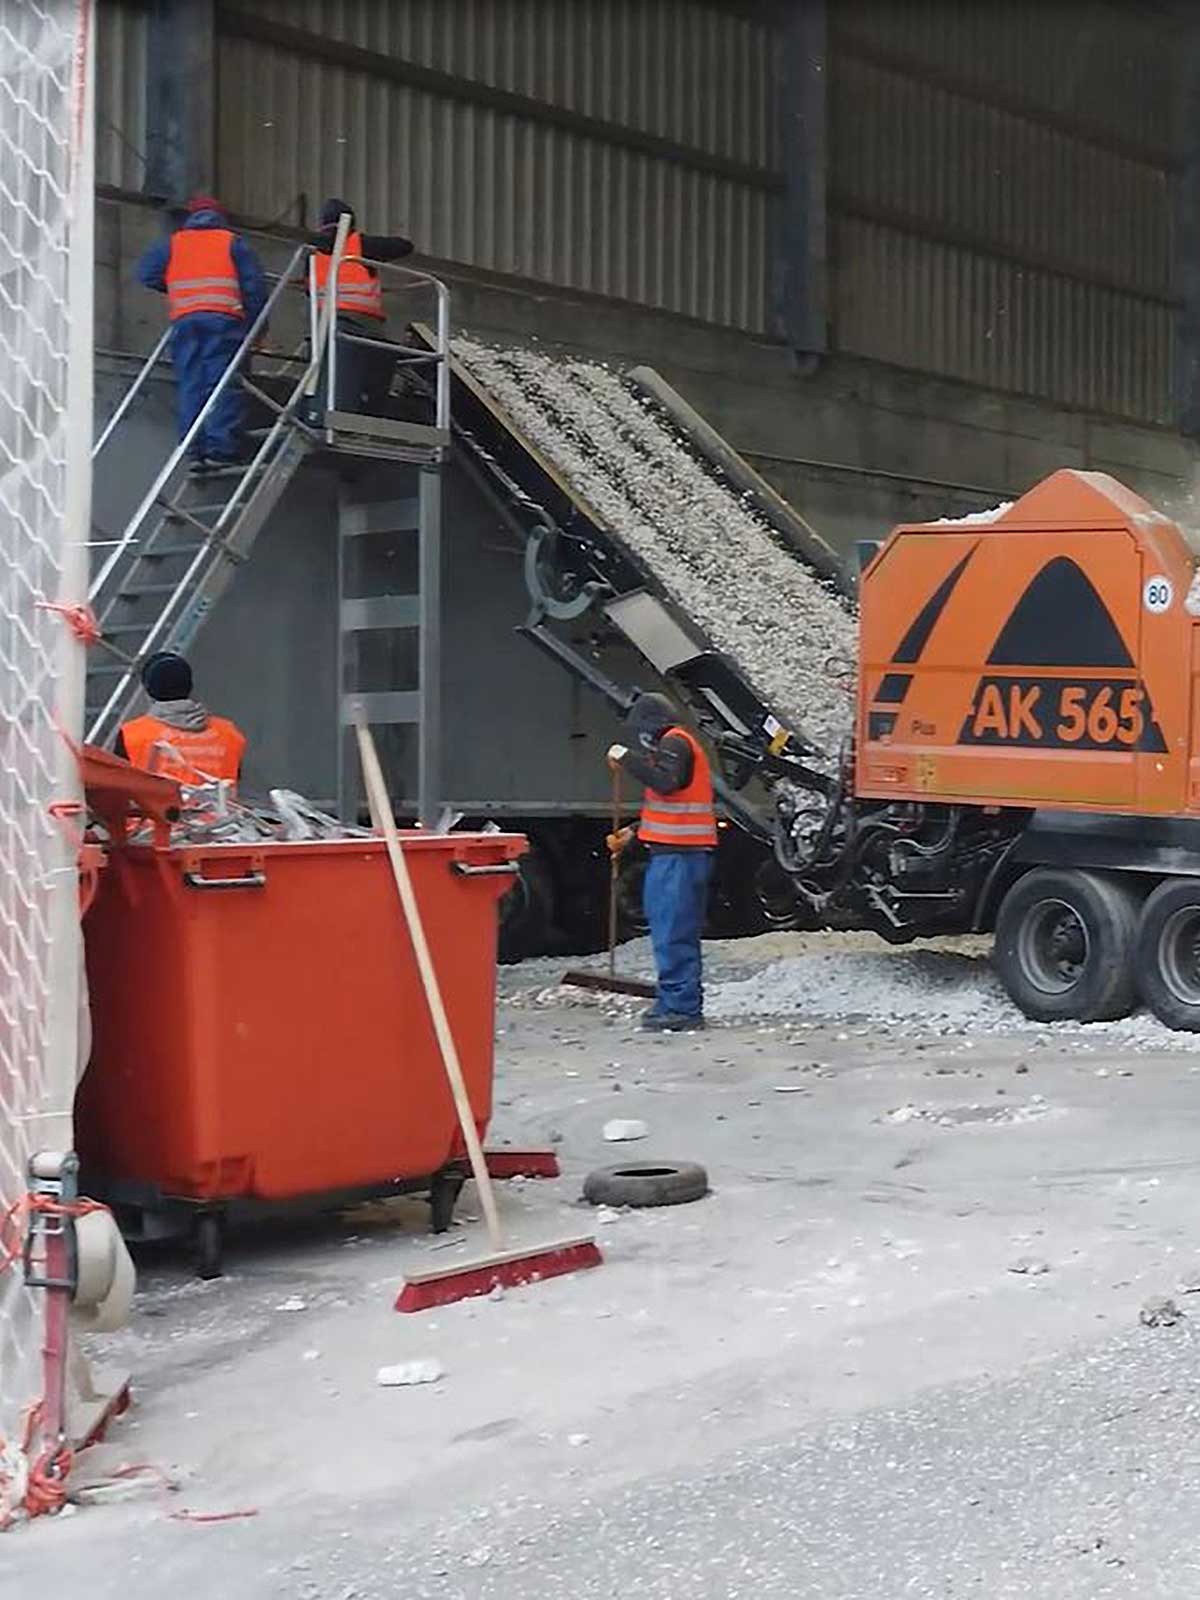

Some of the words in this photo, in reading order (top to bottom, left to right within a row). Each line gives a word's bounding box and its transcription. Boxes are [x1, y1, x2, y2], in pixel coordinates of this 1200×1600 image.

[1148, 584, 1168, 605] 80
[973, 684, 1043, 740] AK
[1056, 686, 1144, 744] 565
